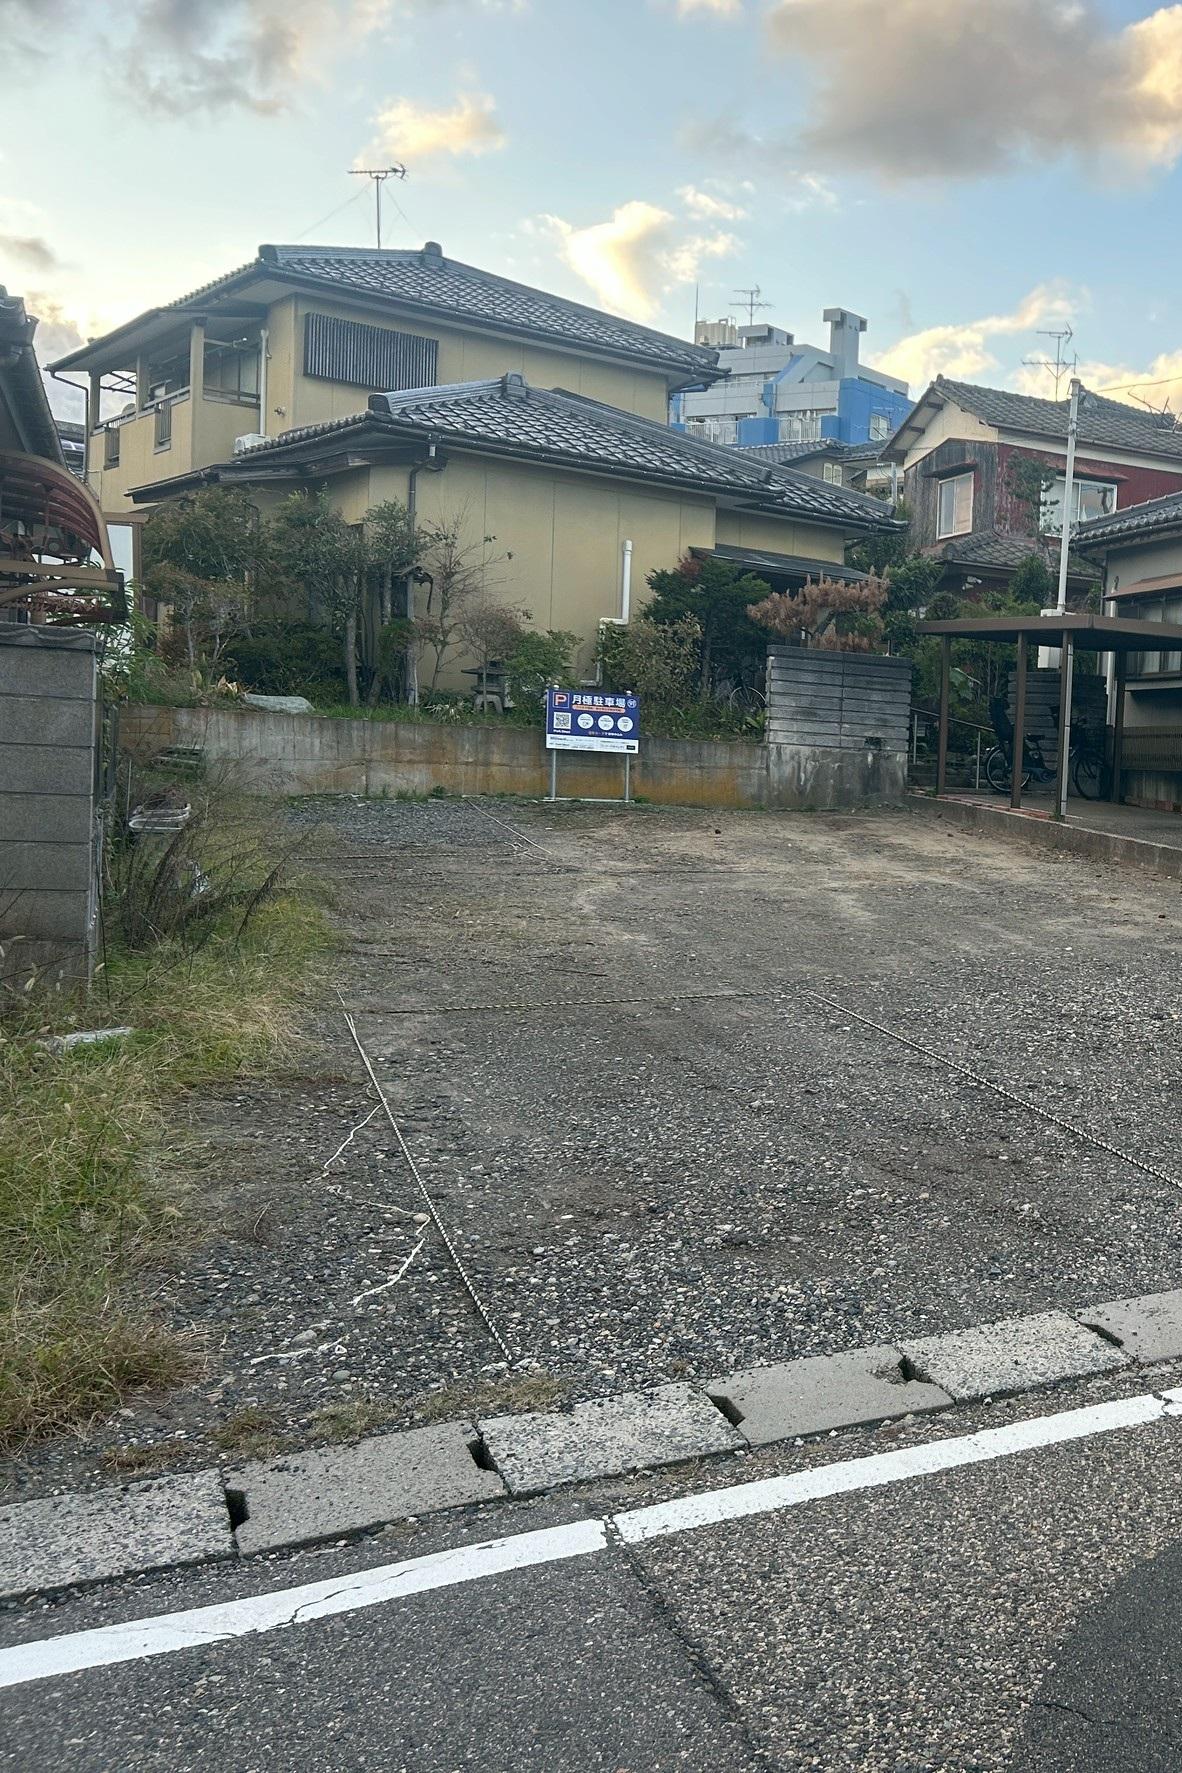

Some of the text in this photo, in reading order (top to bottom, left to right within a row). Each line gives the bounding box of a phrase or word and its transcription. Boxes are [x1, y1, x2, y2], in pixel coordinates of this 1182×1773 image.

[555, 694, 567, 705] P
[572, 695, 626, 708] 月極駐車場
